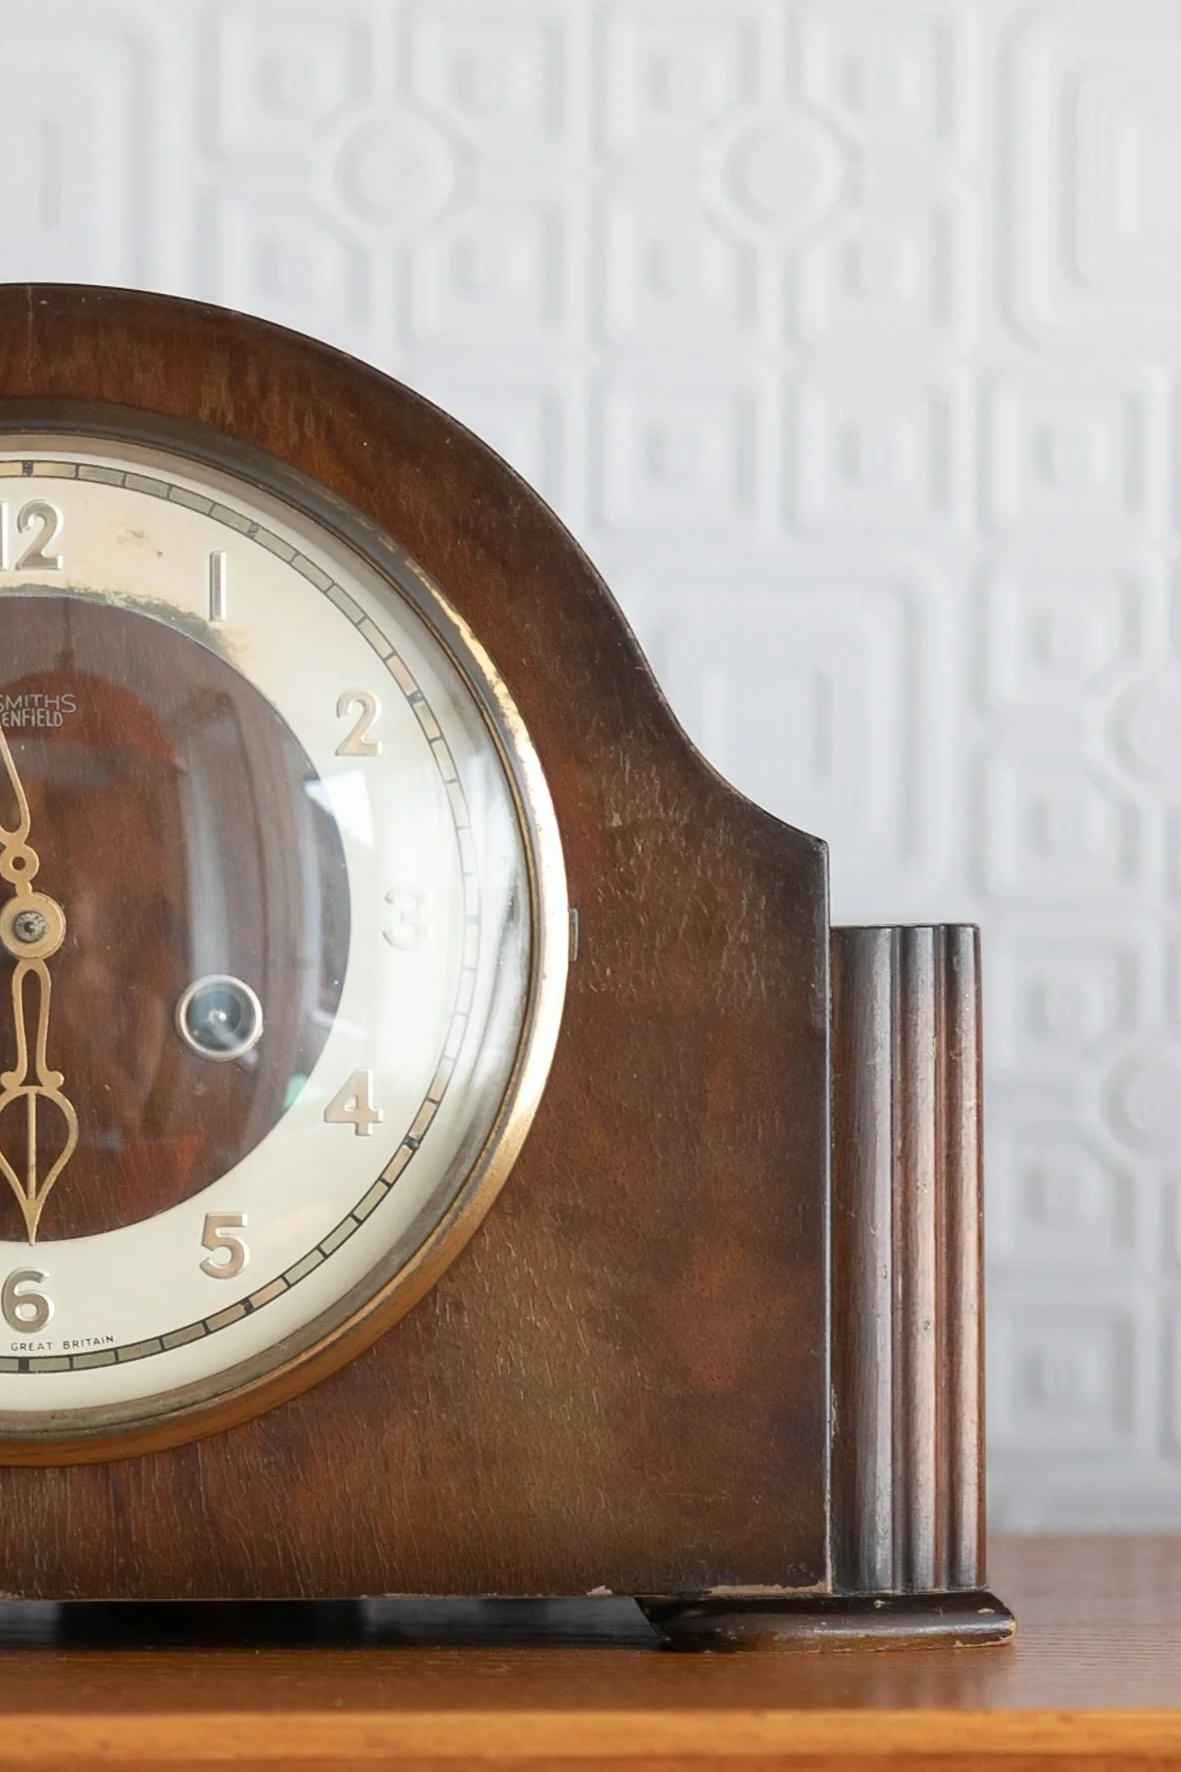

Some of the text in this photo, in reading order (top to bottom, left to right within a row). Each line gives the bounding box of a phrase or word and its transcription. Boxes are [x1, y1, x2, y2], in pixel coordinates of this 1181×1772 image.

[209, 549, 227, 621] 1
[1, 708, 64, 727] ENFIELD
[336, 689, 383, 757] 2
[381, 883, 434, 952] 3
[324, 1067, 384, 1137] 4
[199, 1211, 252, 1280] 5
[1, 1266, 56, 1333] 6
[10, 1342, 53, 1351] GREAT
[62, 1335, 115, 1350] BRITAIN
